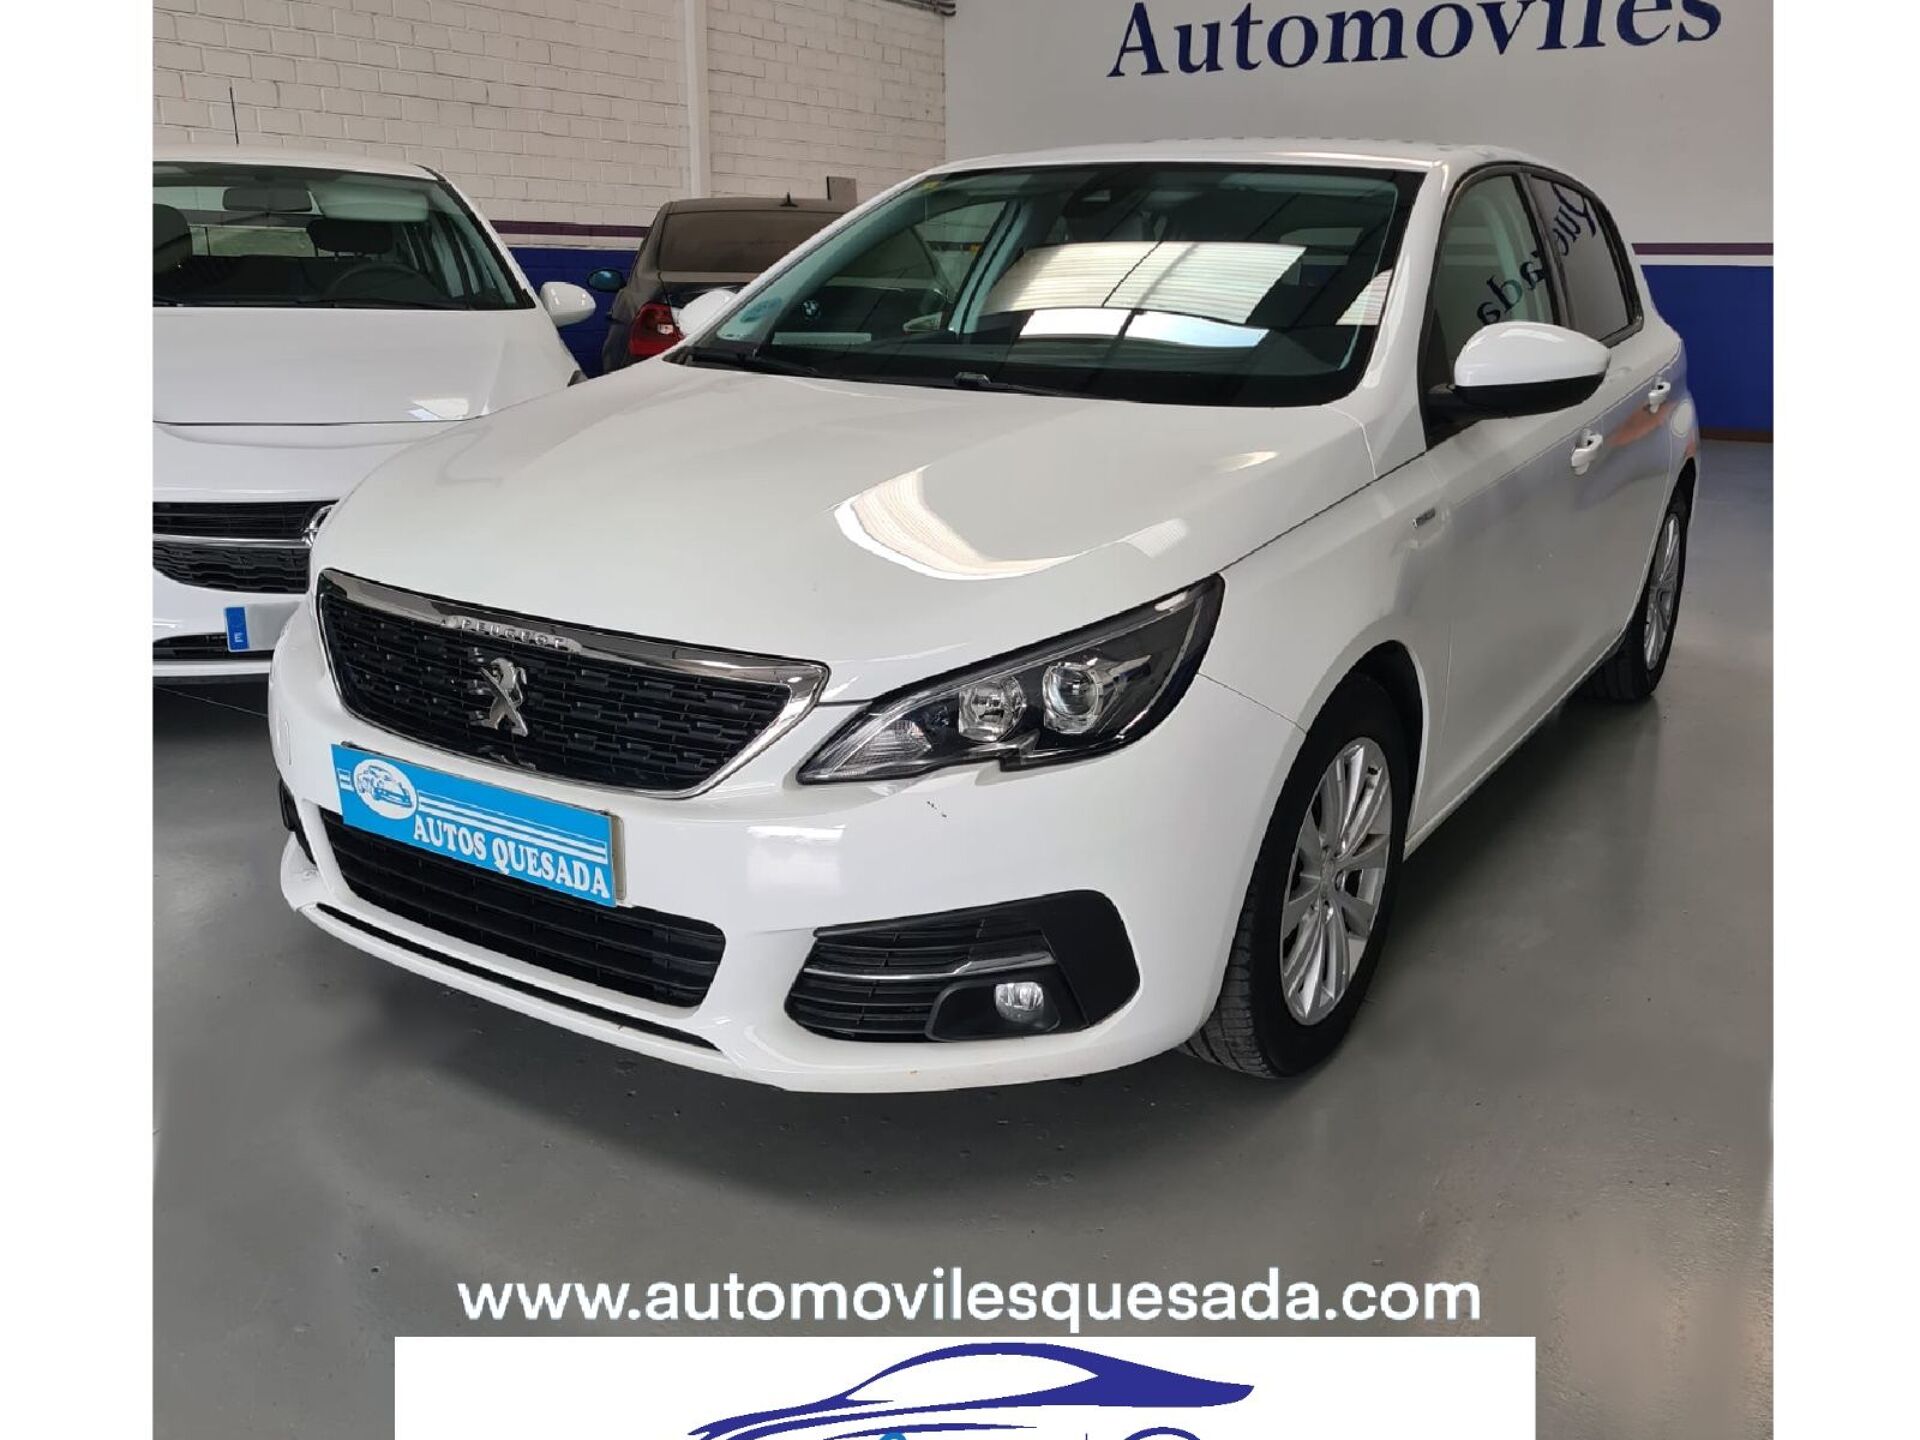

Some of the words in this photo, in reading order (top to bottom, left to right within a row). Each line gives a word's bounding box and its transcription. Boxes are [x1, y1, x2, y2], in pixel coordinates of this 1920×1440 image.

[1106, 0, 1722, 77] Automoviles
[234, 631, 244, 643] E
[461, 618, 565, 649] PEUGEOT
[413, 814, 487, 862] AUTOS
[491, 832, 611, 899] QUESADA
